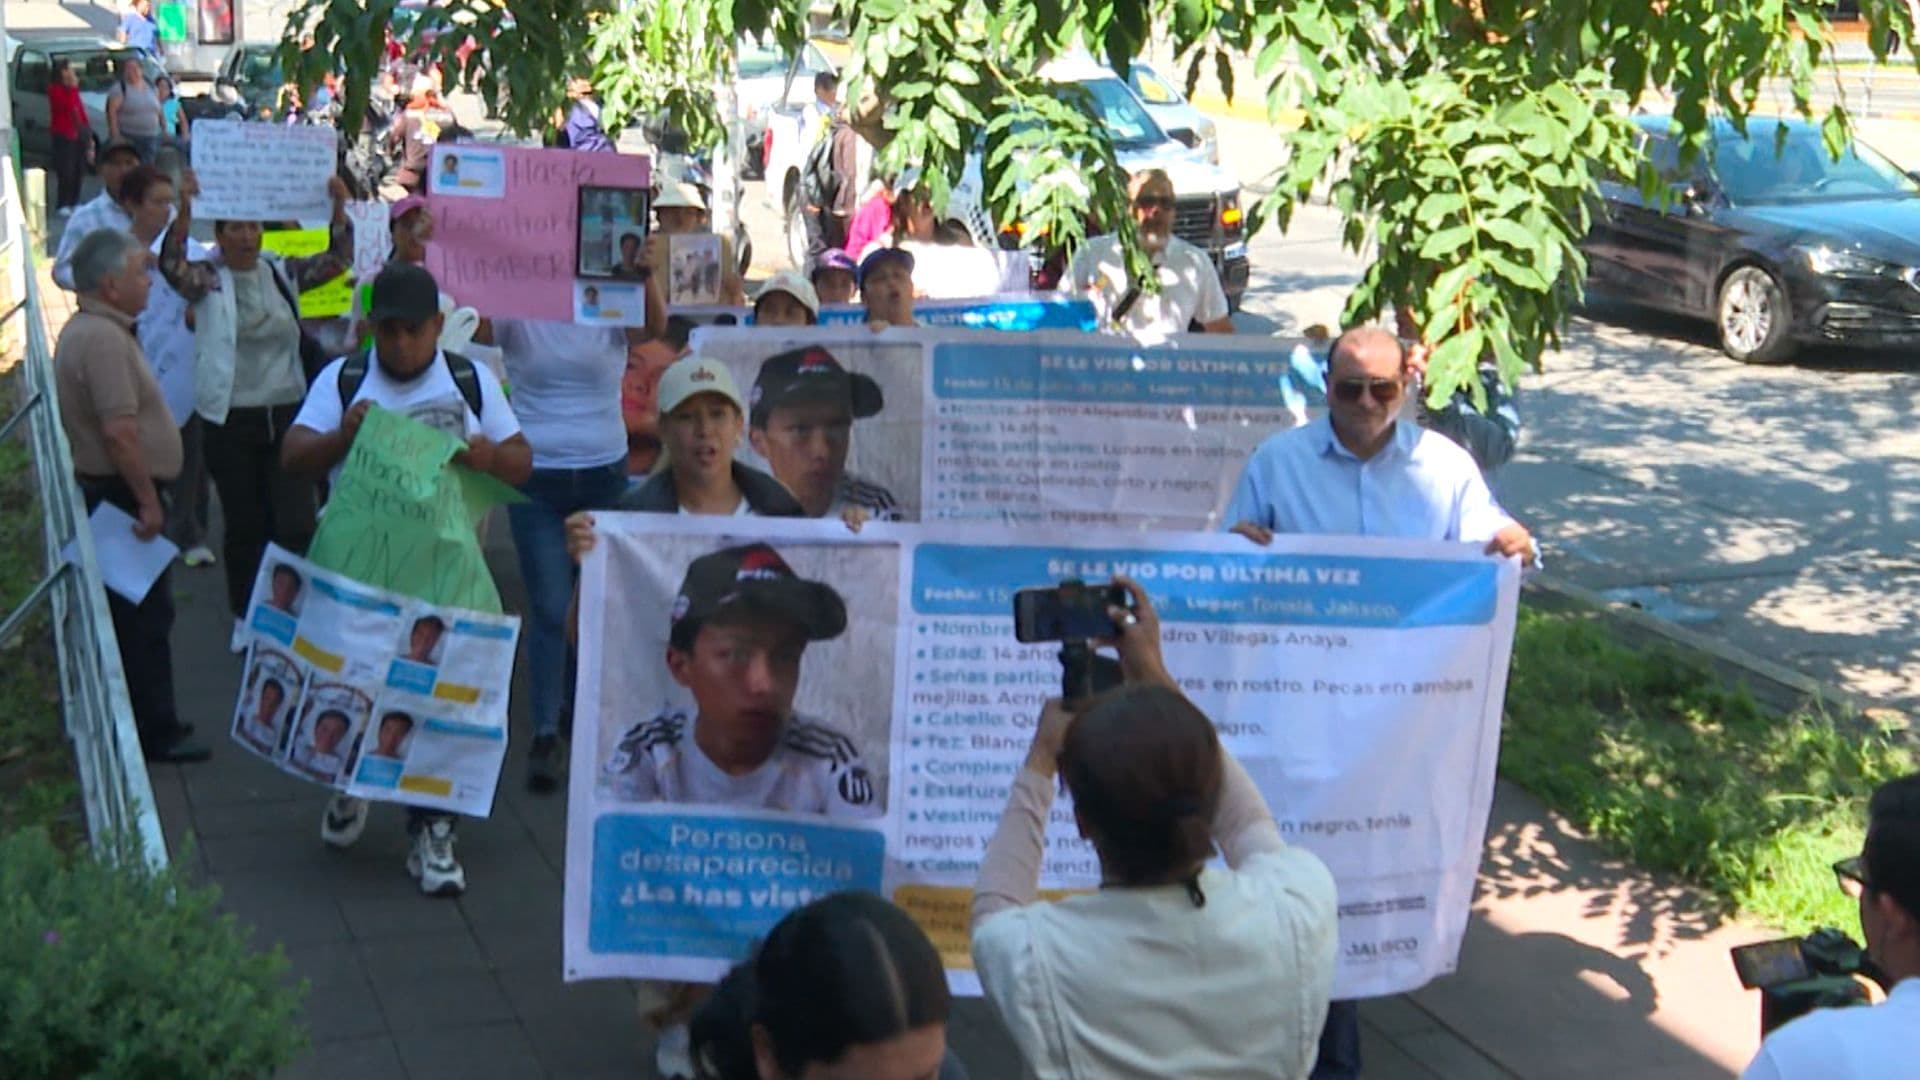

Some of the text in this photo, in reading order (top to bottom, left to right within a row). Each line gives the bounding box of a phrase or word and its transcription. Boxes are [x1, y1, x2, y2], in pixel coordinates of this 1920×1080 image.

[442, 252, 570, 288] HUMBER
[1068, 356, 1088, 369] LE
[1133, 358, 1172, 372] OR
[1047, 560, 1361, 586] SE LE VIO POR ÚLTIMA VEZ
[933, 621, 1011, 636] Nombre
[1201, 628, 1279, 648] Villegas
[1285, 630, 1352, 650] Anaya.
[932, 644, 1058, 661] Edad: 14 año
[930, 667, 1058, 686] Señas particu
[1212, 678, 1239, 693] en
[1313, 678, 1374, 696] Pecas
[1379, 679, 1407, 696] en
[1411, 676, 1474, 695] ambas
[1214, 720, 1265, 737] egro.
[971, 734, 1031, 750] Blanc
[925, 758, 1019, 777] Complexi
[924, 783, 1009, 799] Estatura
[669, 823, 807, 851] Persona
[904, 834, 975, 852] negros
[619, 847, 854, 881] desaparecida
[683, 882, 743, 908] has
[749, 882, 820, 908] vist
[1345, 936, 1419, 957] JALISCO
